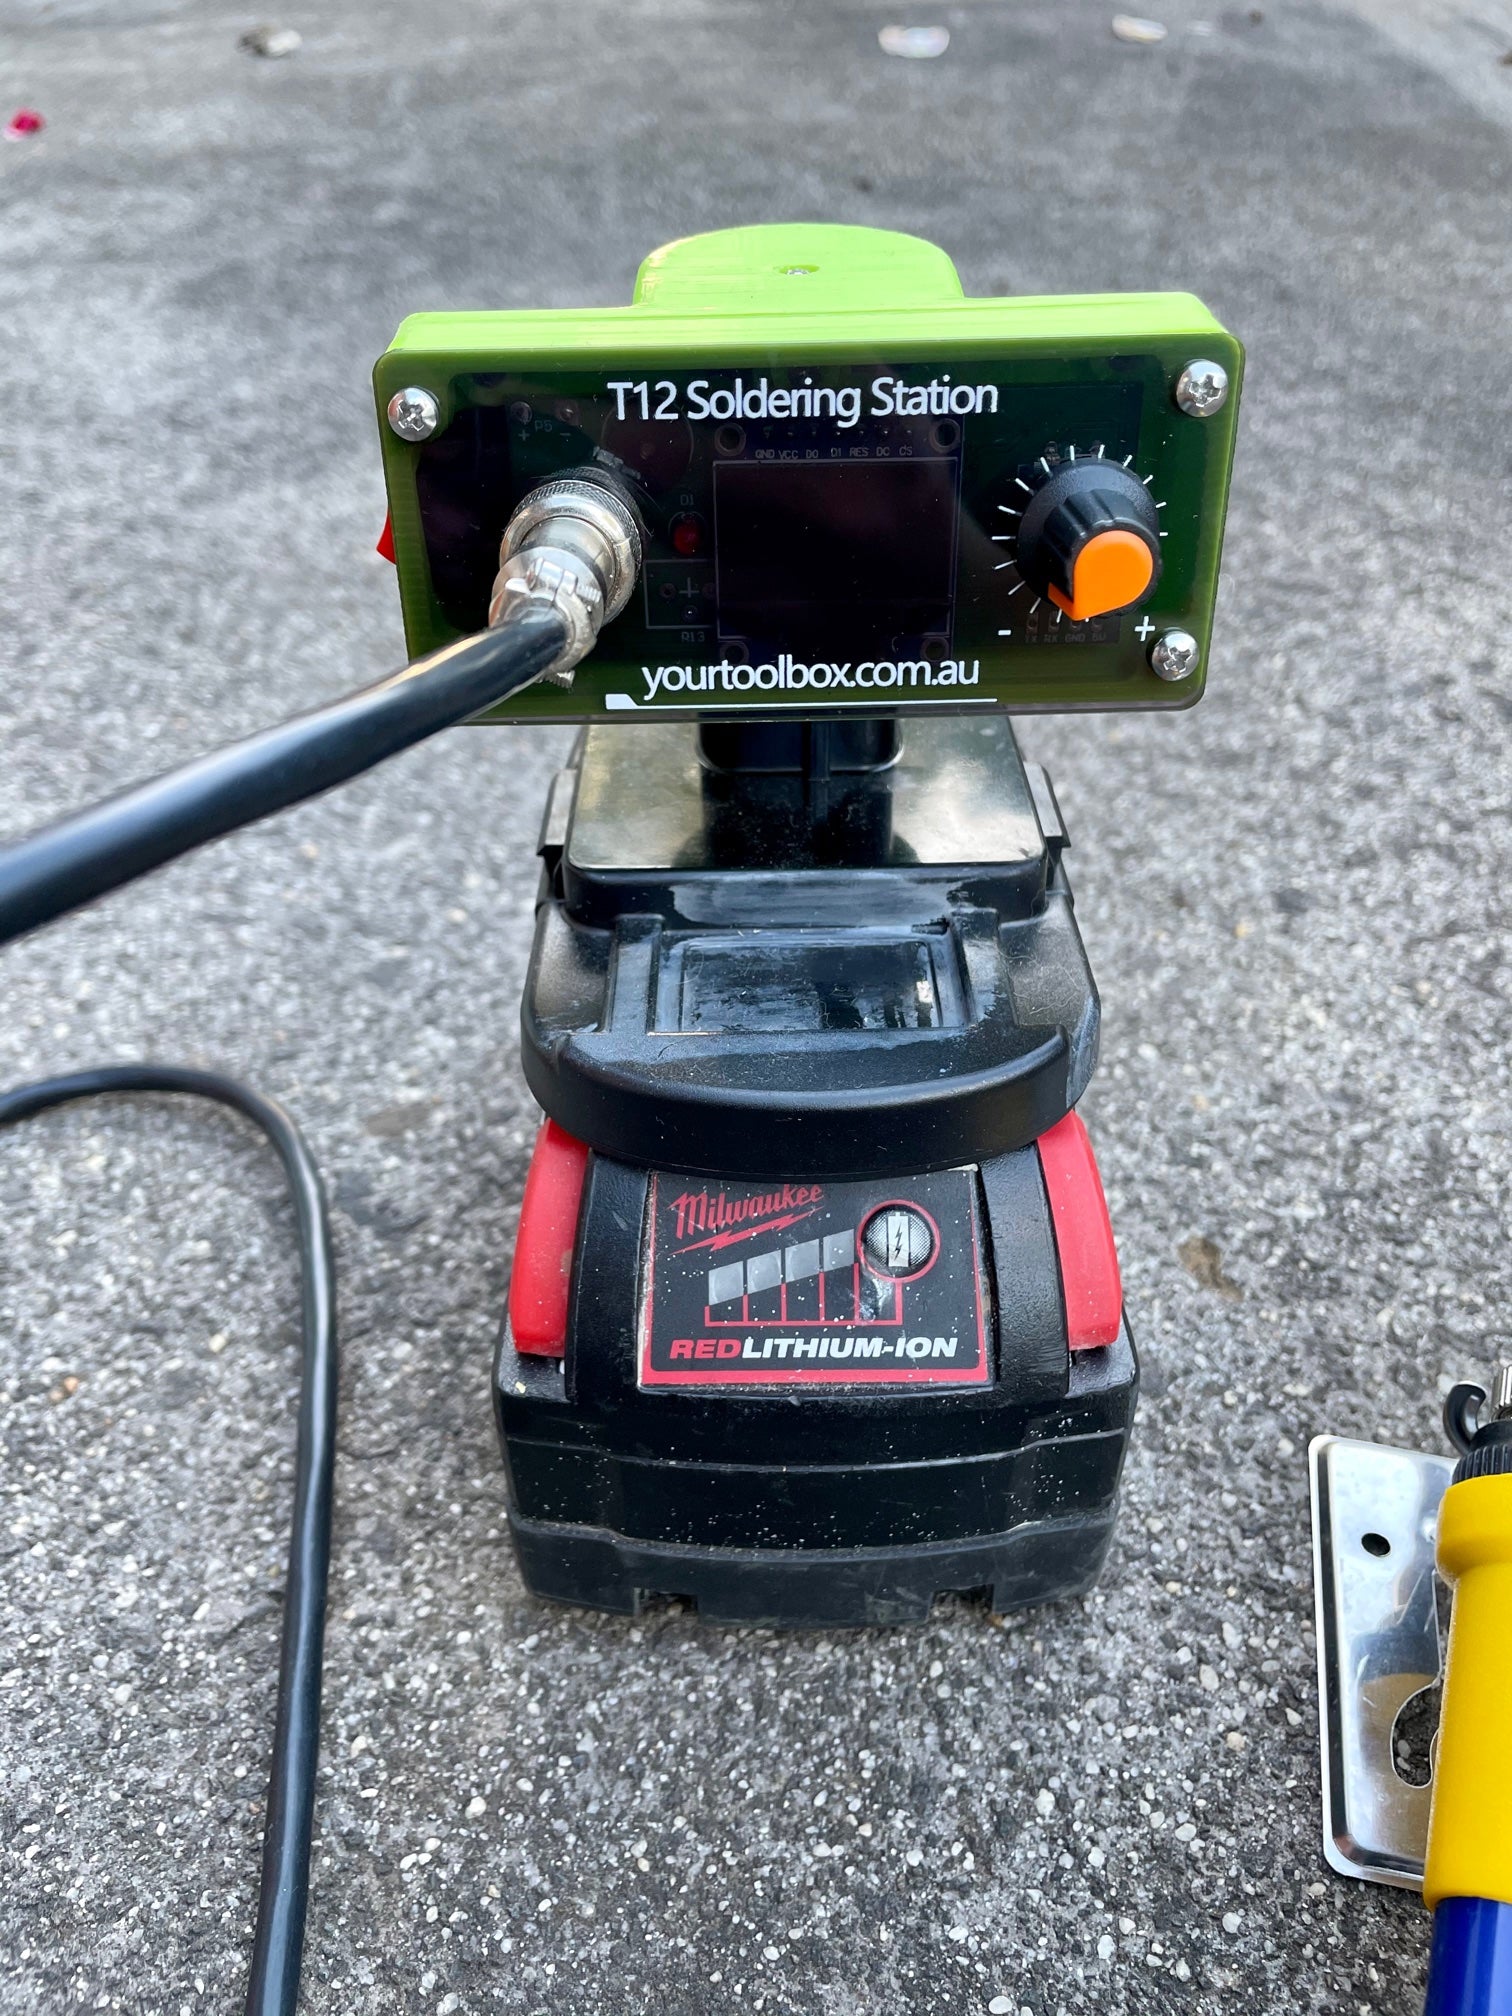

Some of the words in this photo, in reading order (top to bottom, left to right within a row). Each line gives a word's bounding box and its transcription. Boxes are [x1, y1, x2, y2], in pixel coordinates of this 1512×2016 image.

[607, 381, 680, 420] T12
[687, 376, 861, 428] Soldering
[871, 374, 999, 416] Station
[754, 449, 775, 459] GND
[778, 449, 799, 460] VCC
[849, 447, 869, 457] RES
[876, 446, 890, 456] DC
[641, 655, 980, 701] yourtoolbox.com.au
[666, 1184, 825, 1239] Milwaukee
